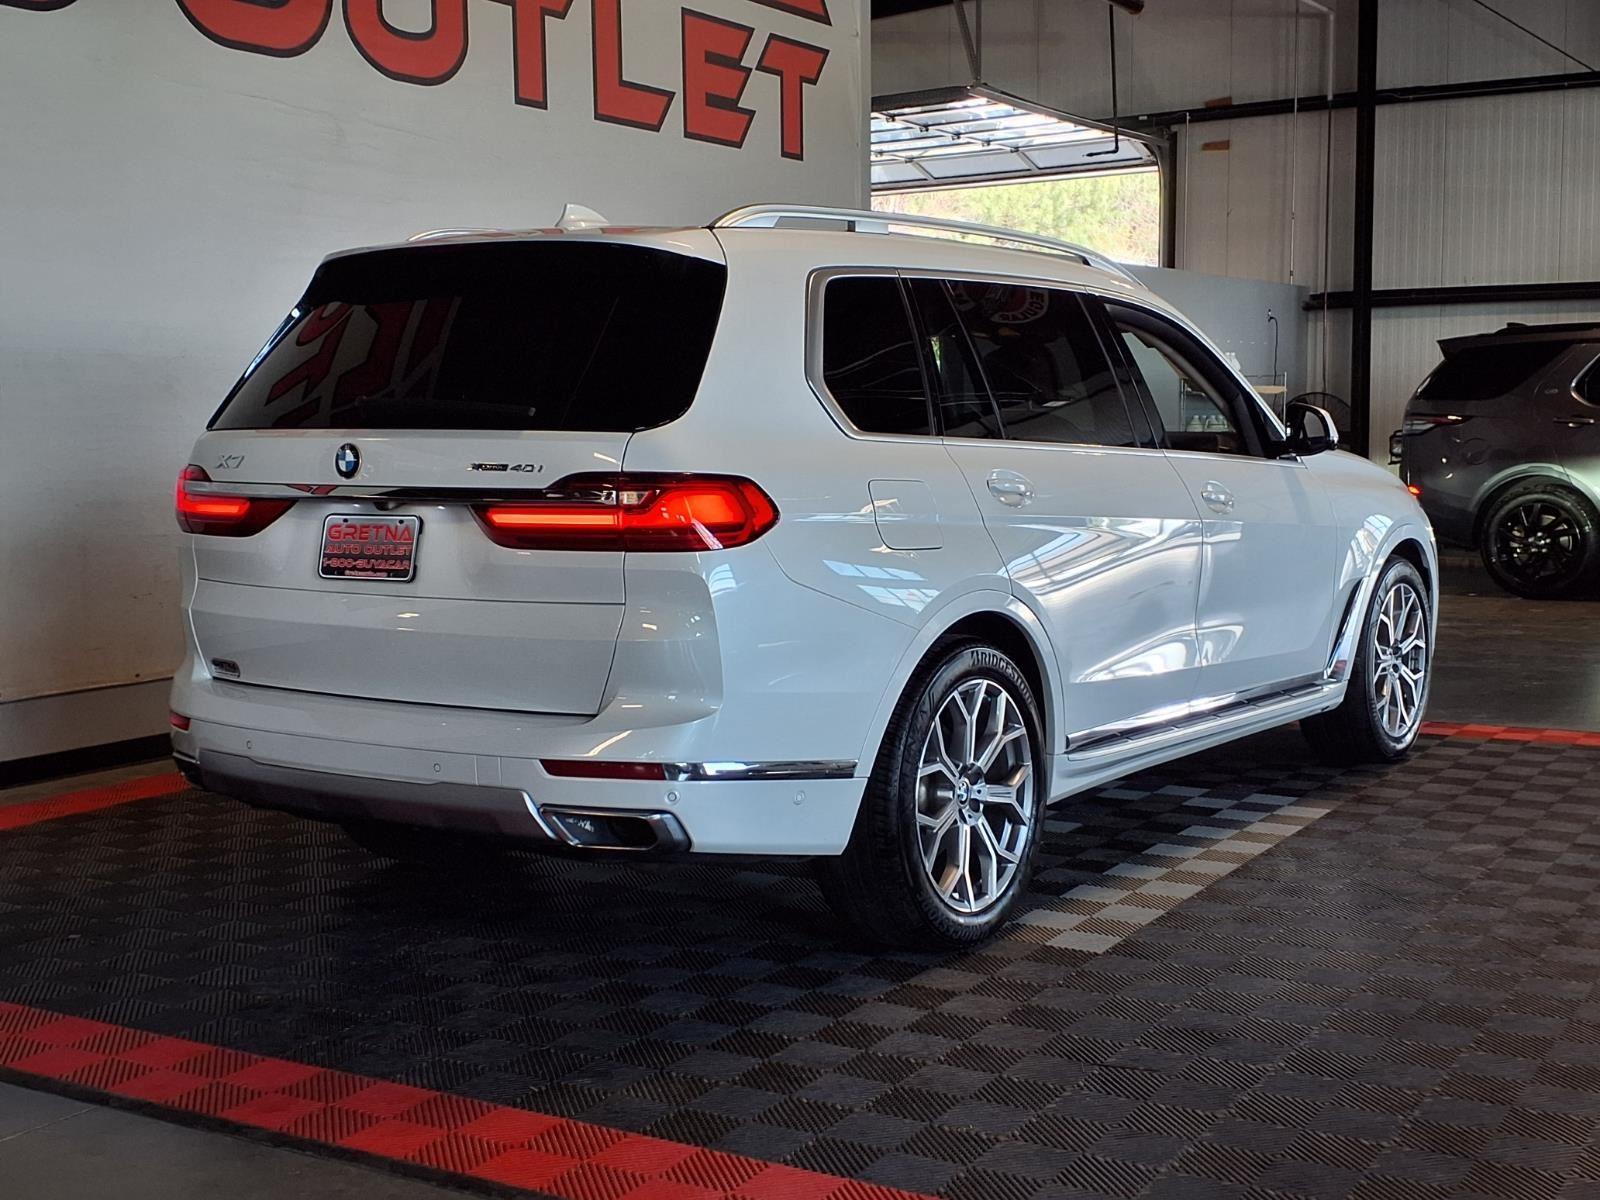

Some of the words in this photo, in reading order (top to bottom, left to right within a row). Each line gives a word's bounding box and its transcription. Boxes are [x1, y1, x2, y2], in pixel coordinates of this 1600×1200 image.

[212, 454, 245, 469] X7
[327, 523, 414, 543] GRETNA
[324, 543, 361, 555] AUTO
[363, 544, 412, 556] OUTLET
